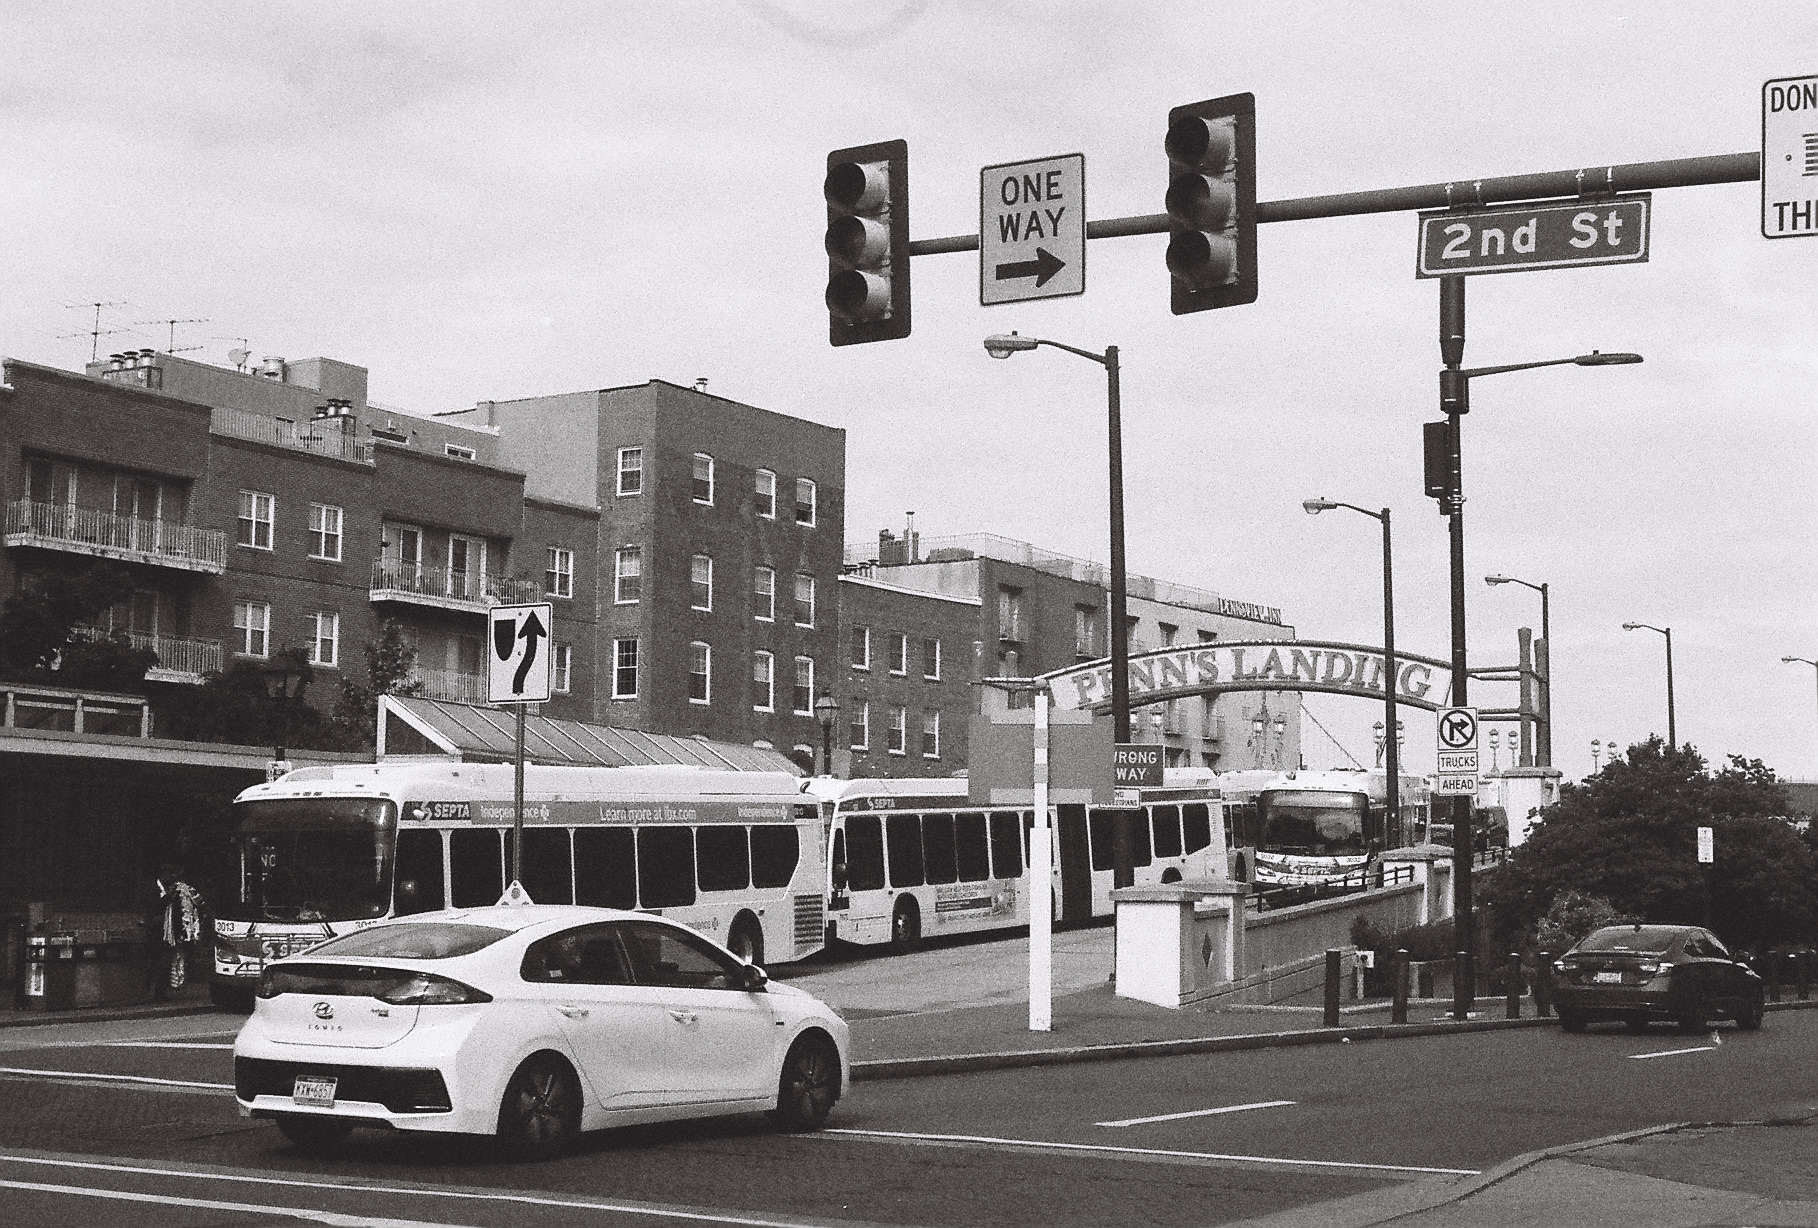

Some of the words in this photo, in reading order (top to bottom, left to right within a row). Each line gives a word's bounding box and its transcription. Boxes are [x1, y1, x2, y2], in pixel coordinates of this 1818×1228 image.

[1001, 169, 1063, 206] ONE
[1772, 200, 1818, 232] TH
[999, 206, 1066, 244] WAY
[1441, 217, 1537, 260] 2nd
[1569, 209, 1623, 249] St
[1071, 650, 1219, 705] PENN'S
[1230, 648, 1432, 698] LANDING
[1114, 751, 1157, 764] RONG
[1440, 756, 1476, 768] TRUCKS
[1116, 767, 1147, 781] WAY
[1442, 779, 1474, 790] AHEAD
[434, 803, 470, 818] SEPTA
[874, 798, 896, 809] SEPTA
[480, 804, 539, 821] Indepennce
[600, 805, 627, 821] Learn
[628, 808, 652, 821] more
[653, 806, 663, 821] at
[216, 921, 235, 932] 3013
